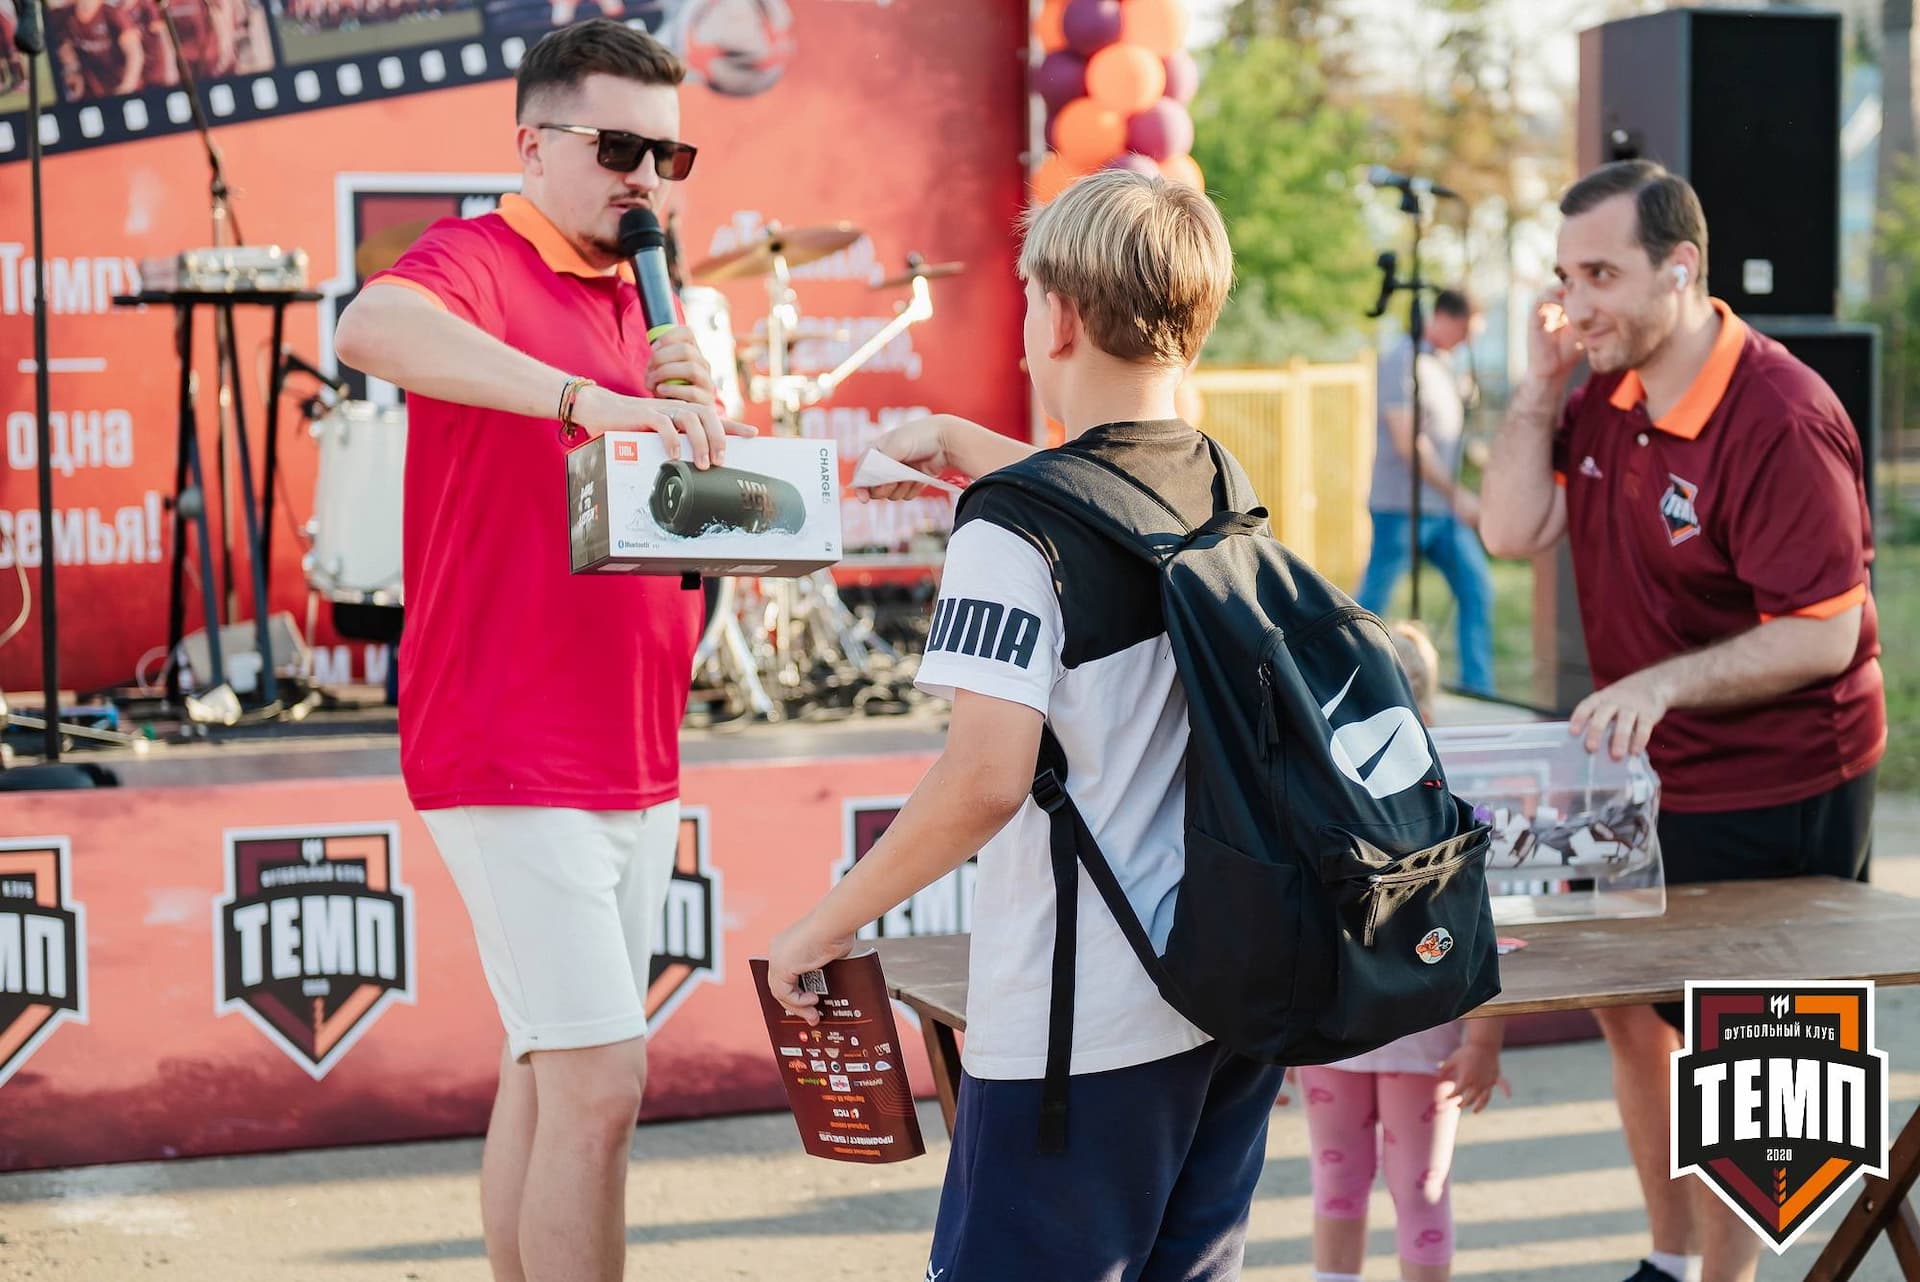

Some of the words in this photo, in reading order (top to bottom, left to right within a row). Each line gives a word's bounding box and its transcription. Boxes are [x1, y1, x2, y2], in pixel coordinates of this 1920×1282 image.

[7, 409, 134, 477] одна
[927, 598, 1041, 670] UMA
[233, 894, 397, 987] ТЕМП
